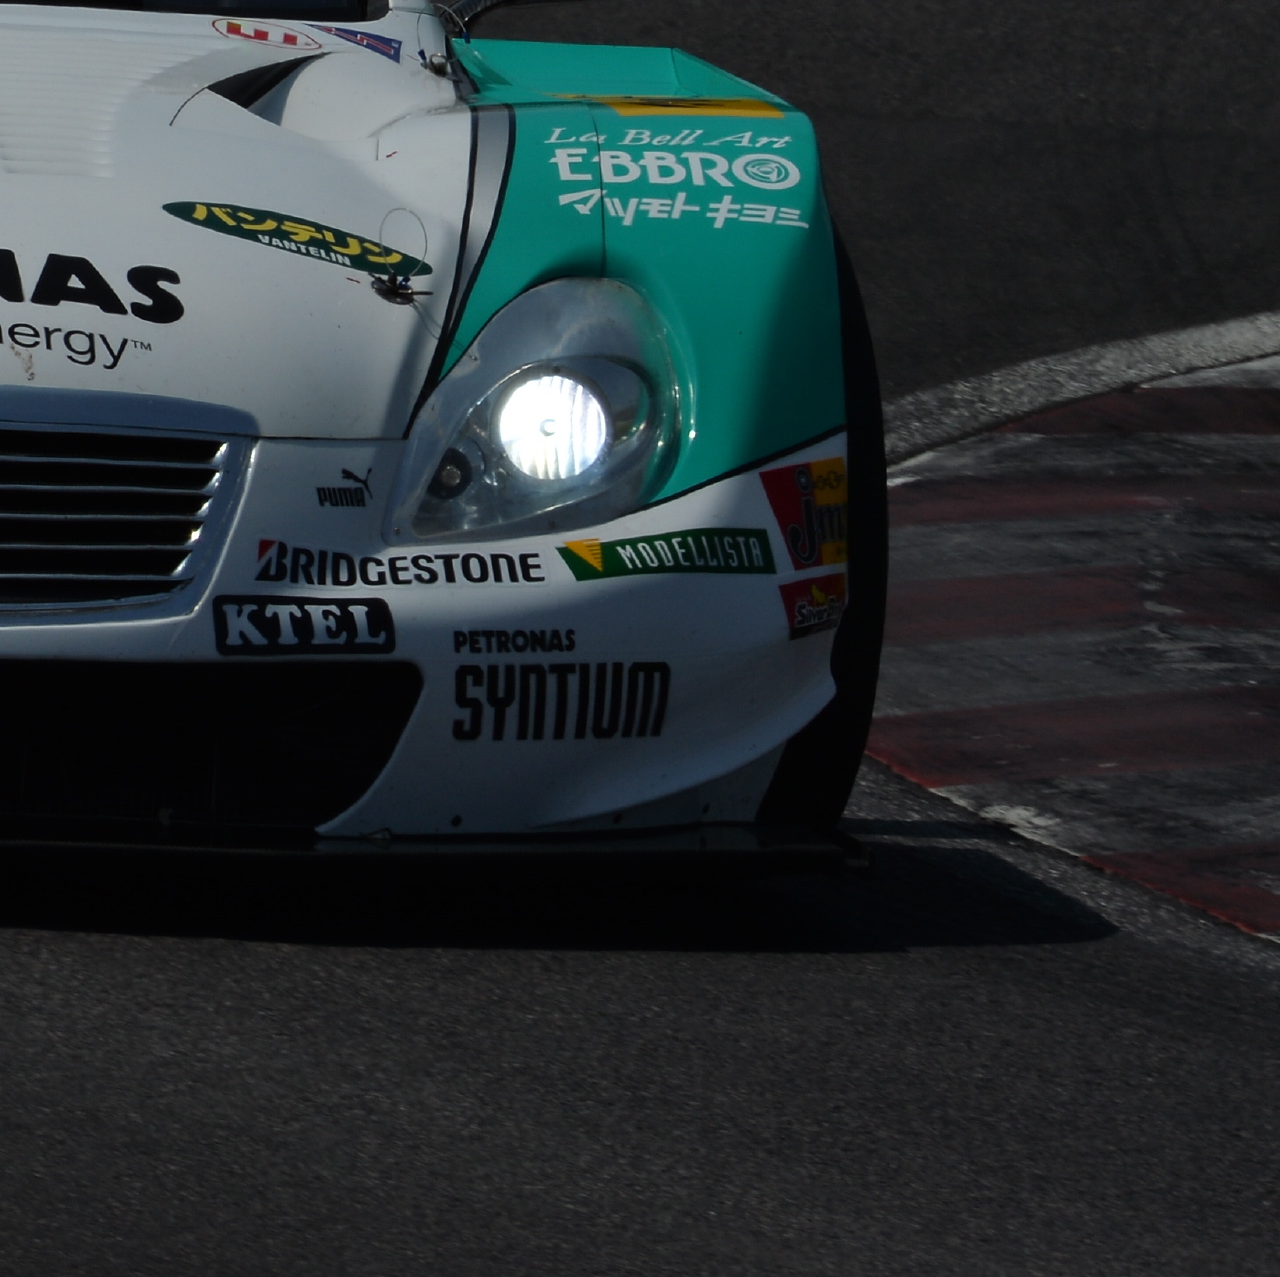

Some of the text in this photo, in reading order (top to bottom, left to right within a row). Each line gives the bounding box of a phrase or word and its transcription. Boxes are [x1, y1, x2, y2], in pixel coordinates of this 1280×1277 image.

[544, 126, 794, 150] La Bell Art
[549, 148, 801, 190] EBBRO
[191, 203, 404, 266] バンテリン
[257, 234, 352, 267] VANTELIN
[315, 486, 367, 508] PUMA
[254, 539, 546, 587] BRIDGESTONE
[617, 535, 765, 570] MODELLISTA
[220, 603, 388, 647] KTEL
[453, 629, 576, 654] PETRONAS
[451, 661, 671, 742] SYNTIUM
